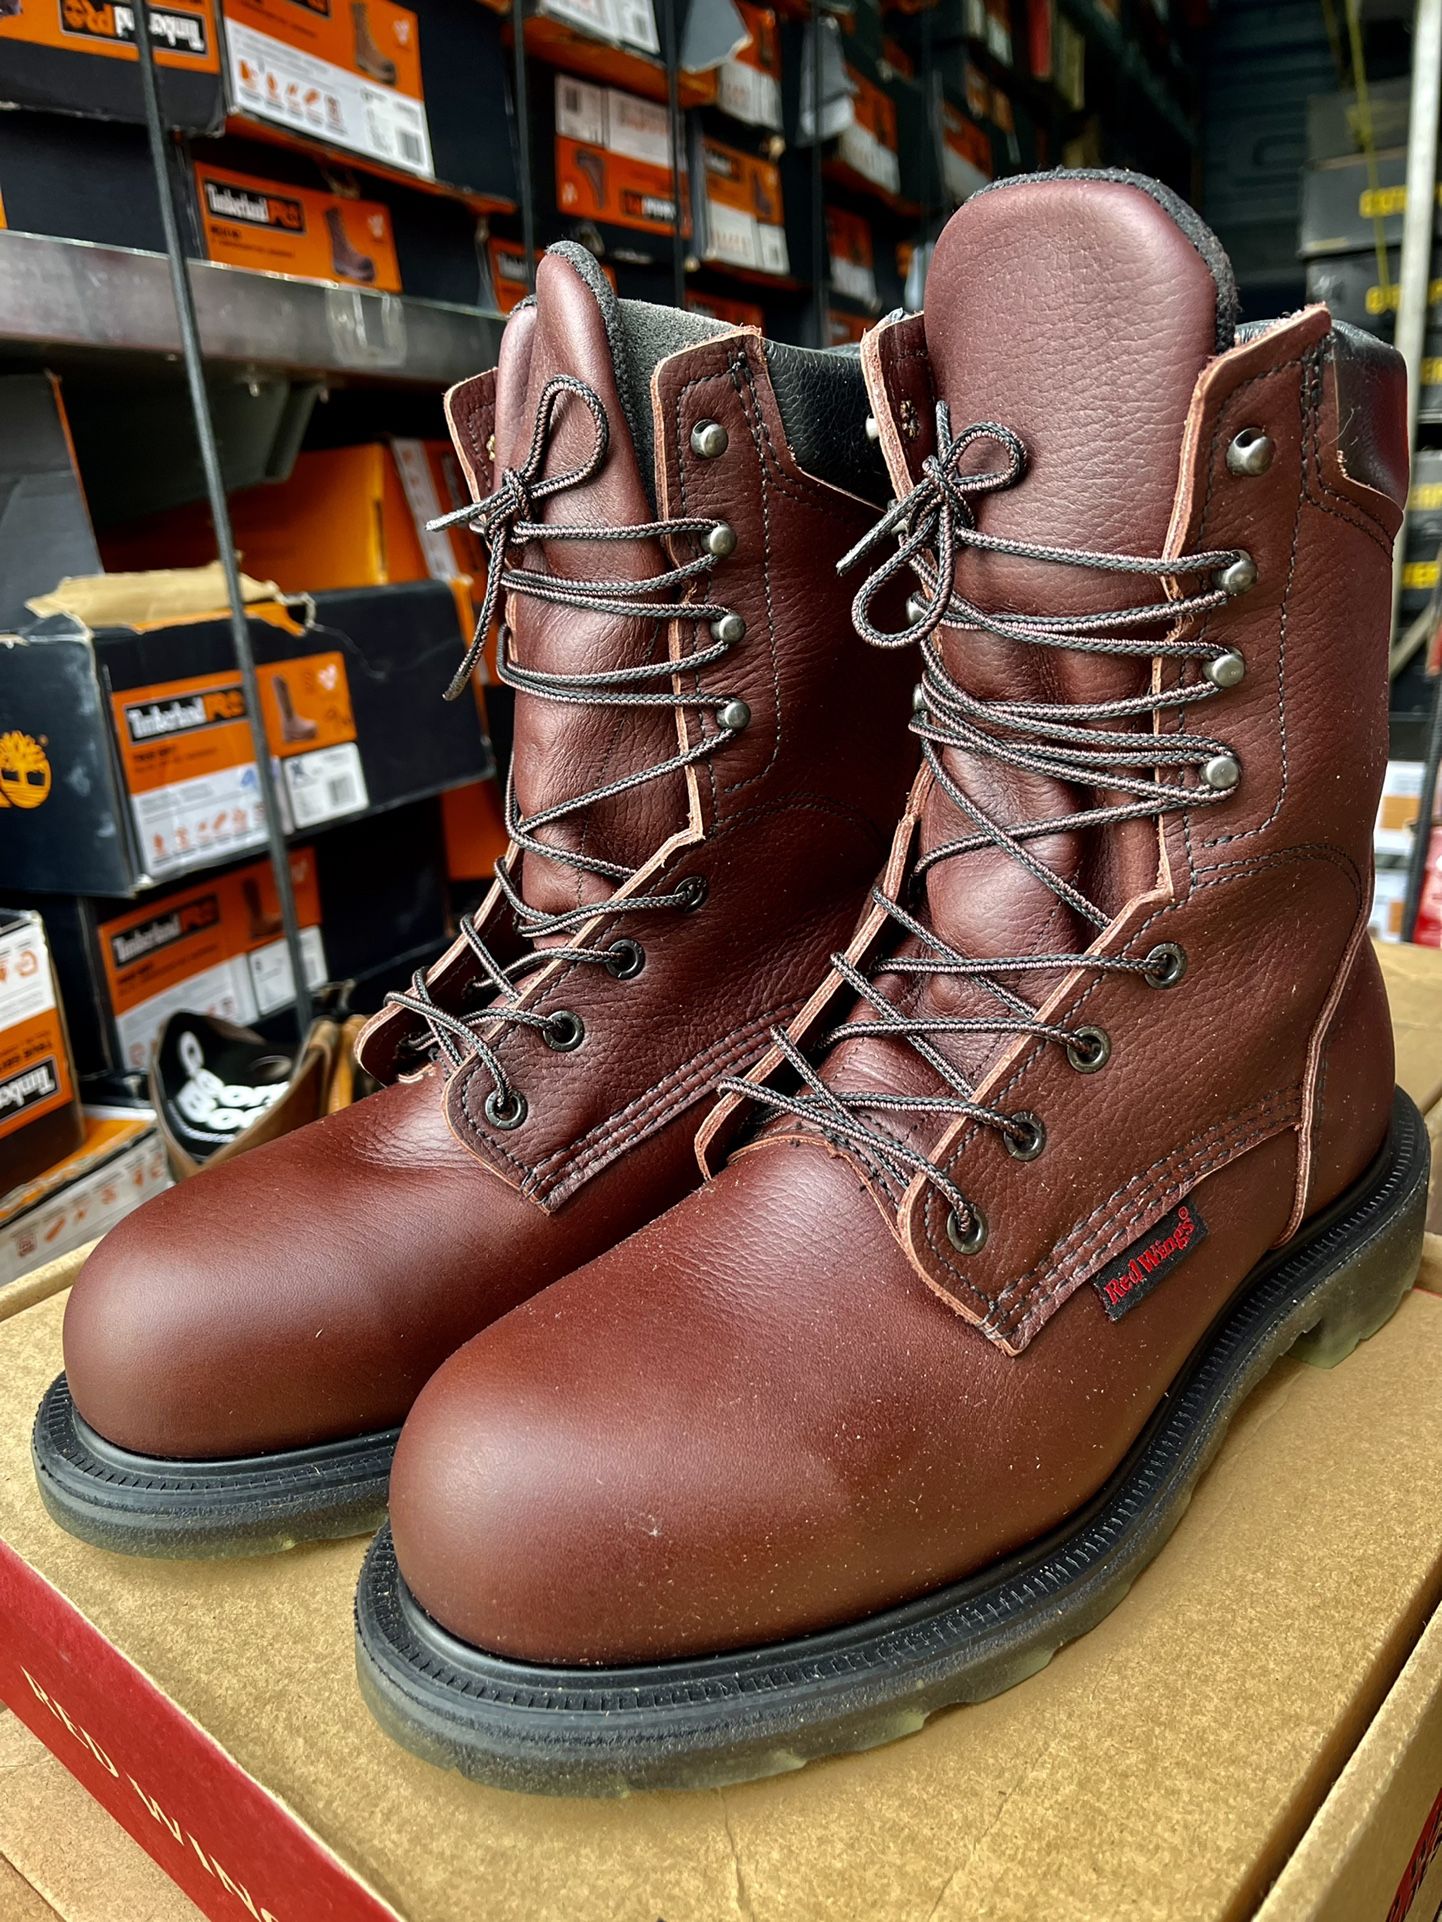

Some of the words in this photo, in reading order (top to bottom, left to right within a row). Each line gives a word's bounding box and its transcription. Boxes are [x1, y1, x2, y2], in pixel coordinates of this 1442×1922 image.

[113, 6, 205, 51] Timbernd
[0, 1065, 55, 1109] Timbe
[1104, 1259, 1144, 1304] Red
[20, 1664, 120, 1778] RED
[123, 1769, 280, 1922] WIN
